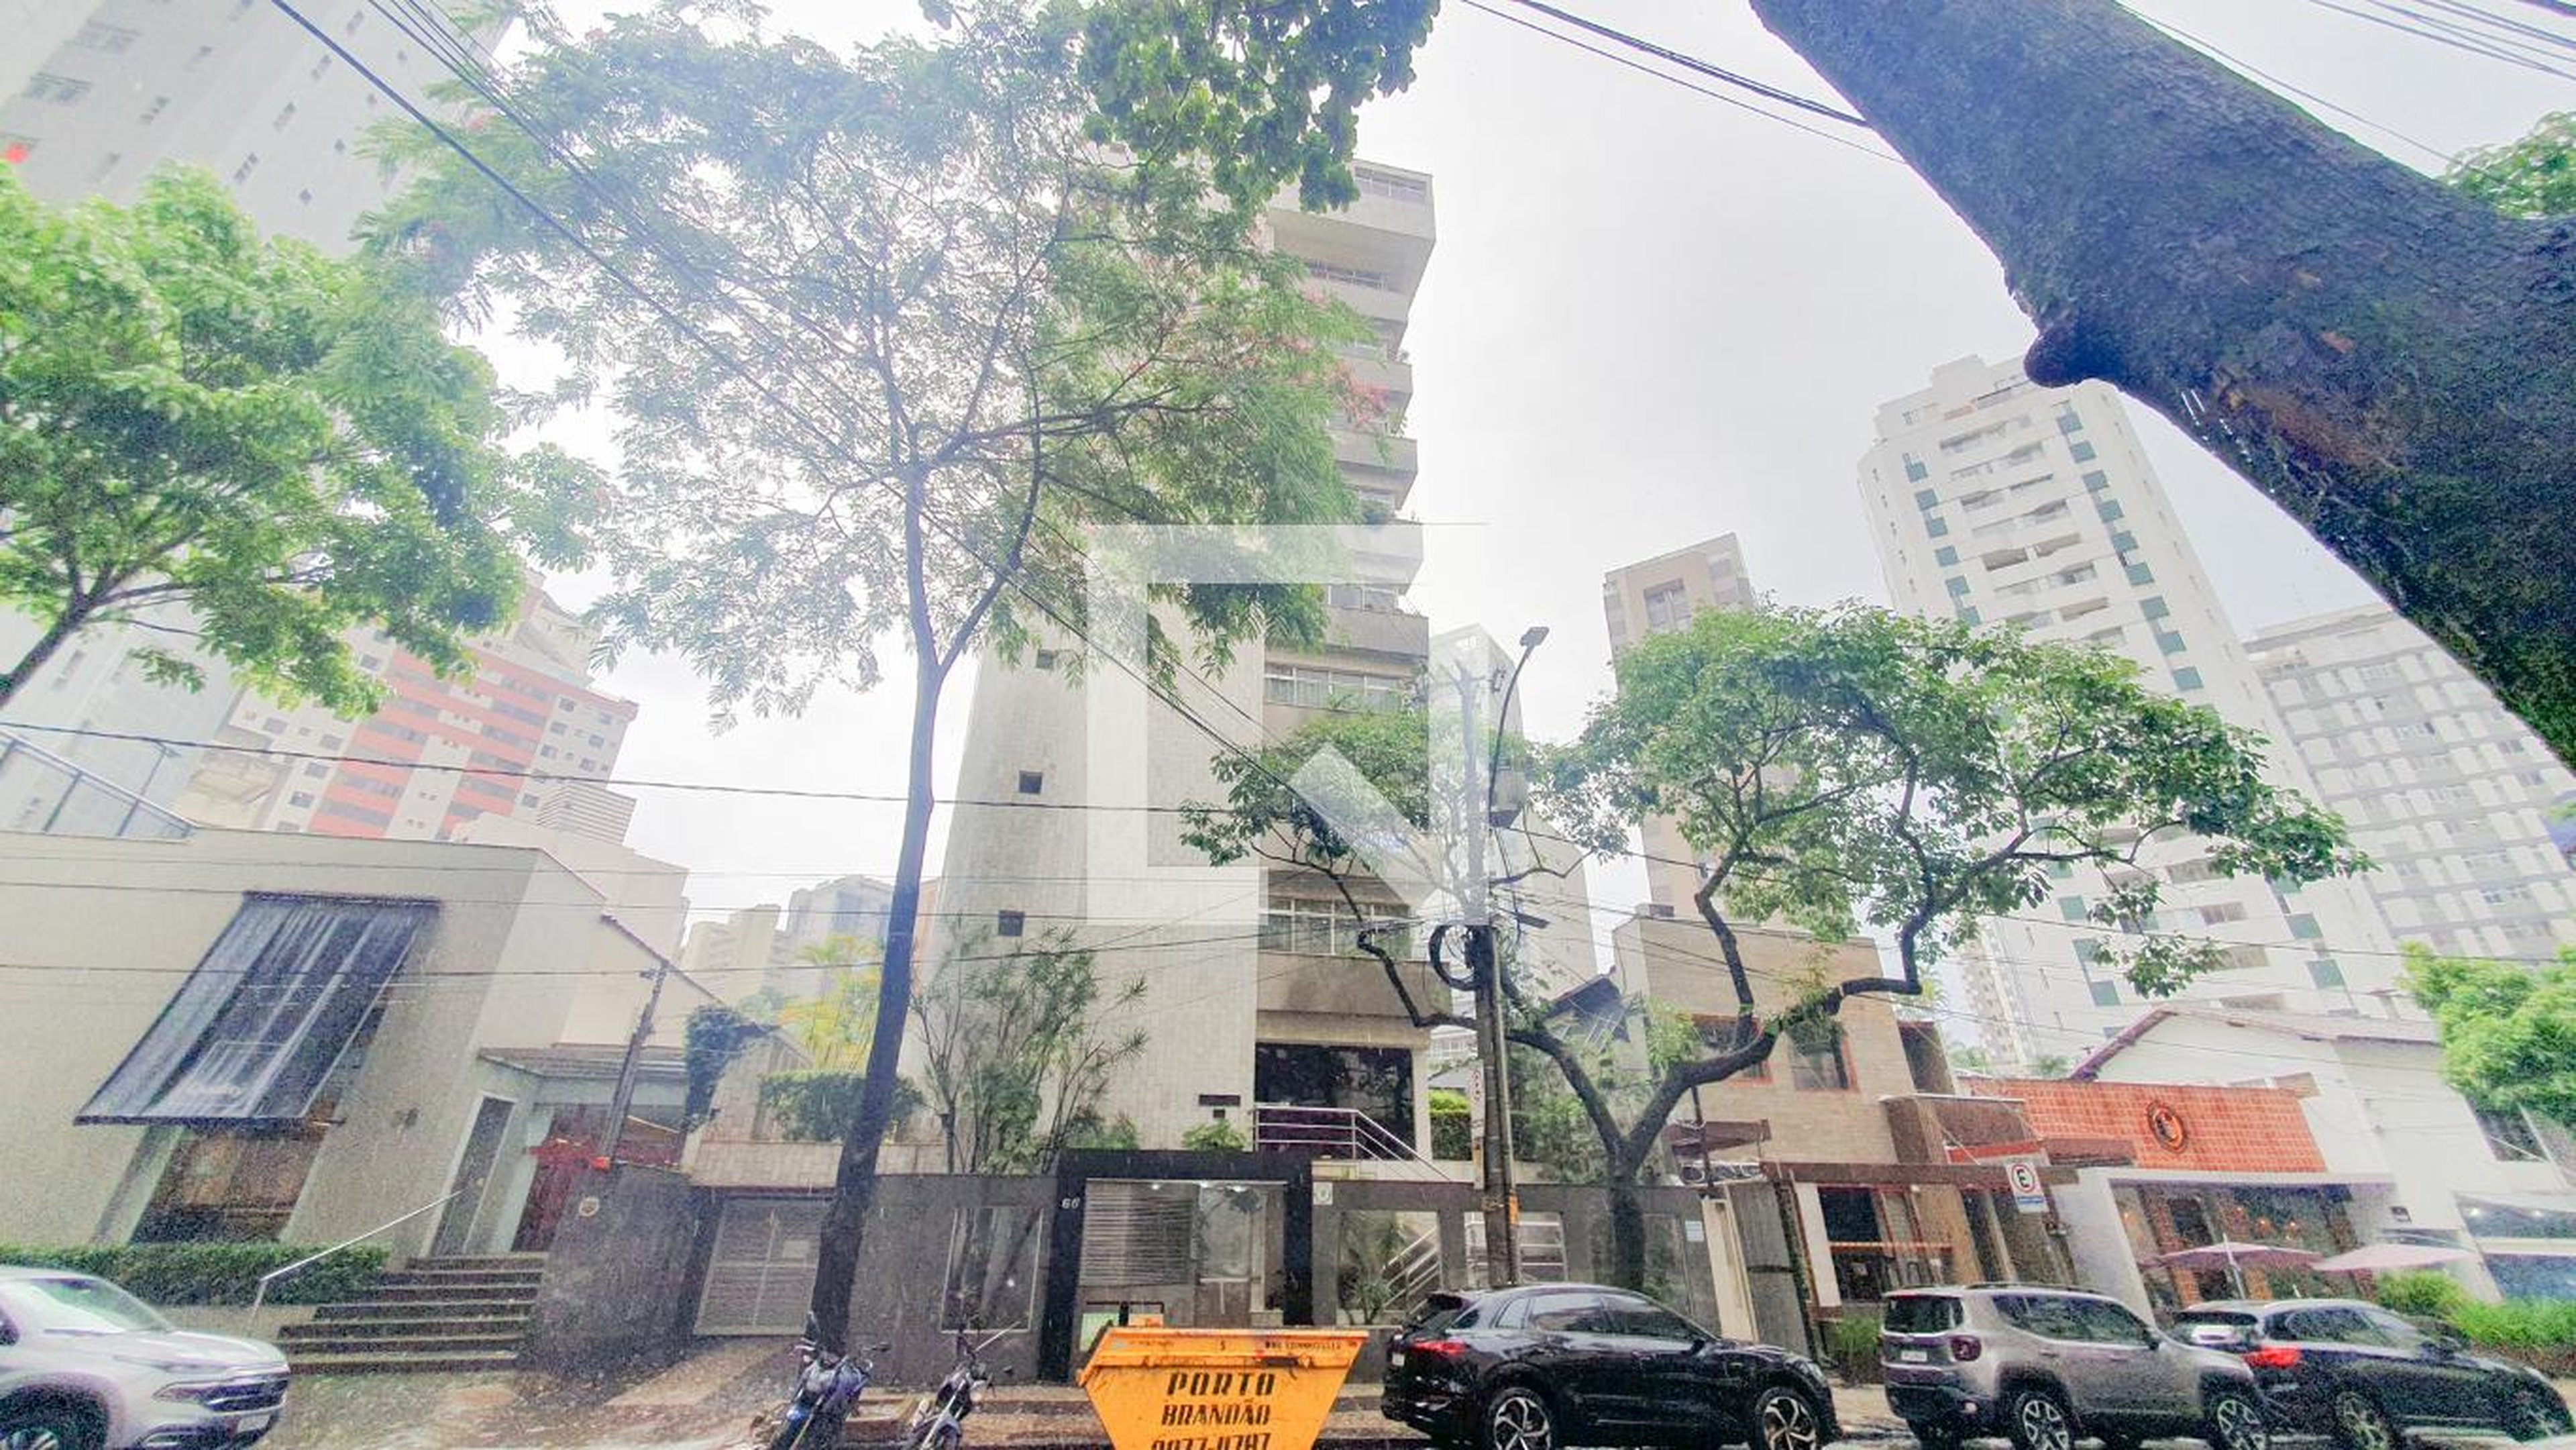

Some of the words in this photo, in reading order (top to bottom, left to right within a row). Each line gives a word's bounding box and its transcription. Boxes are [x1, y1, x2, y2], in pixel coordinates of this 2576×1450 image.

[2017, 1168, 2030, 1188] E
[1167, 1373, 1275, 1396] PORTO
[1161, 1398, 1271, 1426] BRANDÃO
